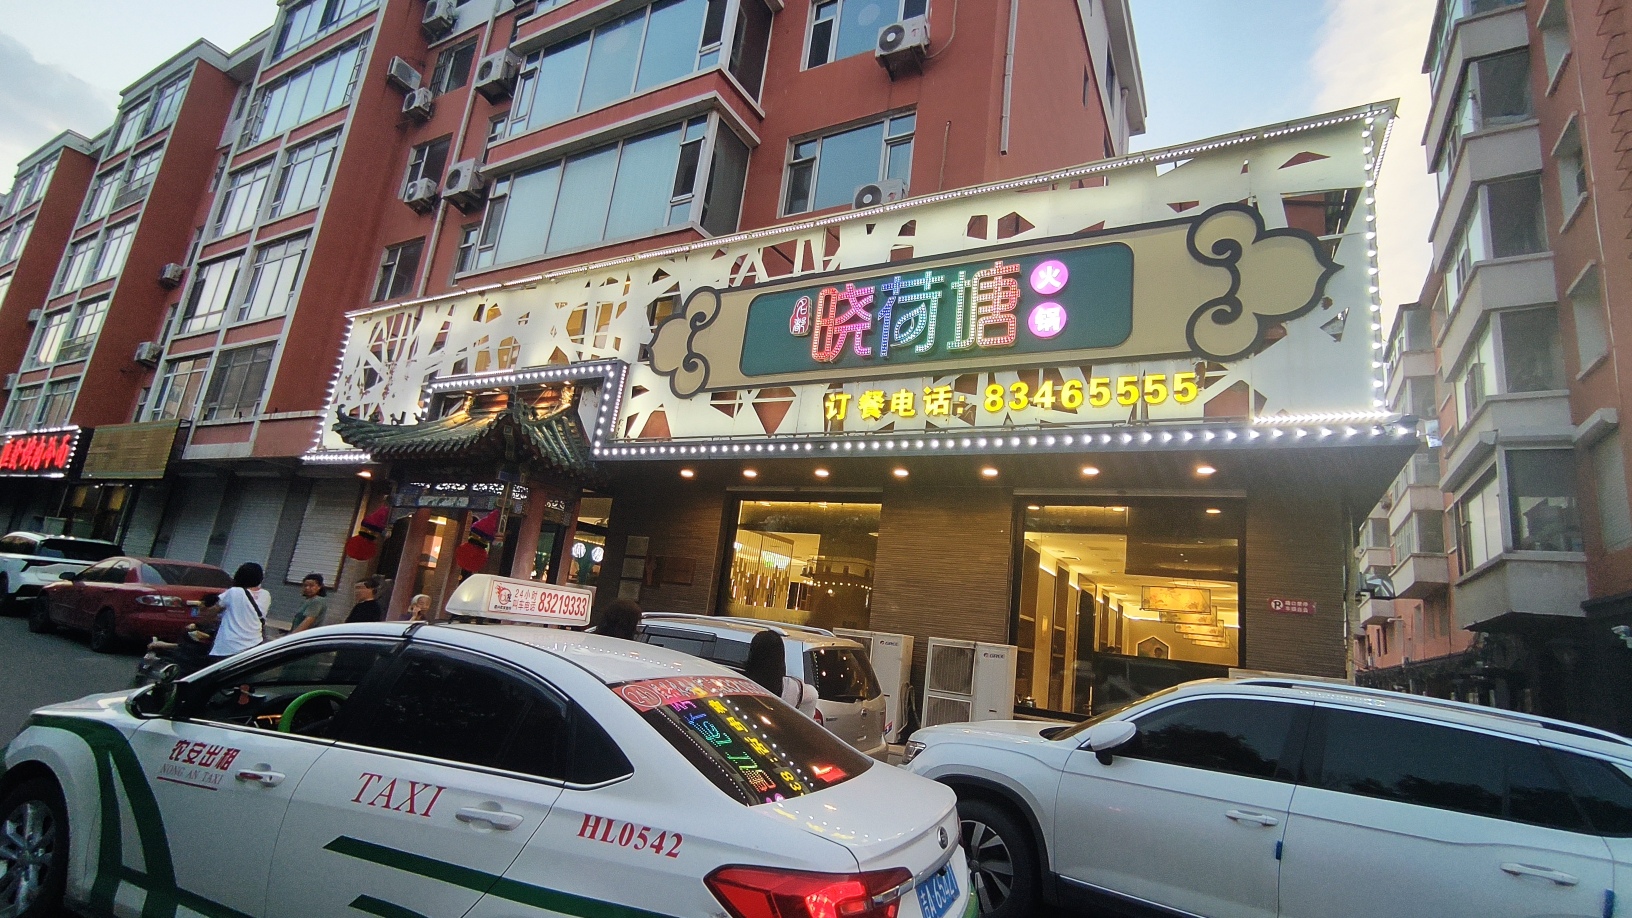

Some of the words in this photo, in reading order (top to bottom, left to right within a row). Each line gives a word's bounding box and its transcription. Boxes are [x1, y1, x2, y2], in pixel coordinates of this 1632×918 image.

[811, 260, 1021, 363] 晓荷塘
[825, 385, 965, 420] 订餐电话:
[983, 372, 1199, 413] 83465555
[538, 592, 588, 617] 83219333
[160, 763, 186, 776] NONG
[186, 770, 201, 780] AN
[201, 771, 224, 785] TAXI
[169, 740, 241, 771] 农安出租
[351, 772, 447, 818] TAXI
[577, 813, 684, 859] HL0542
